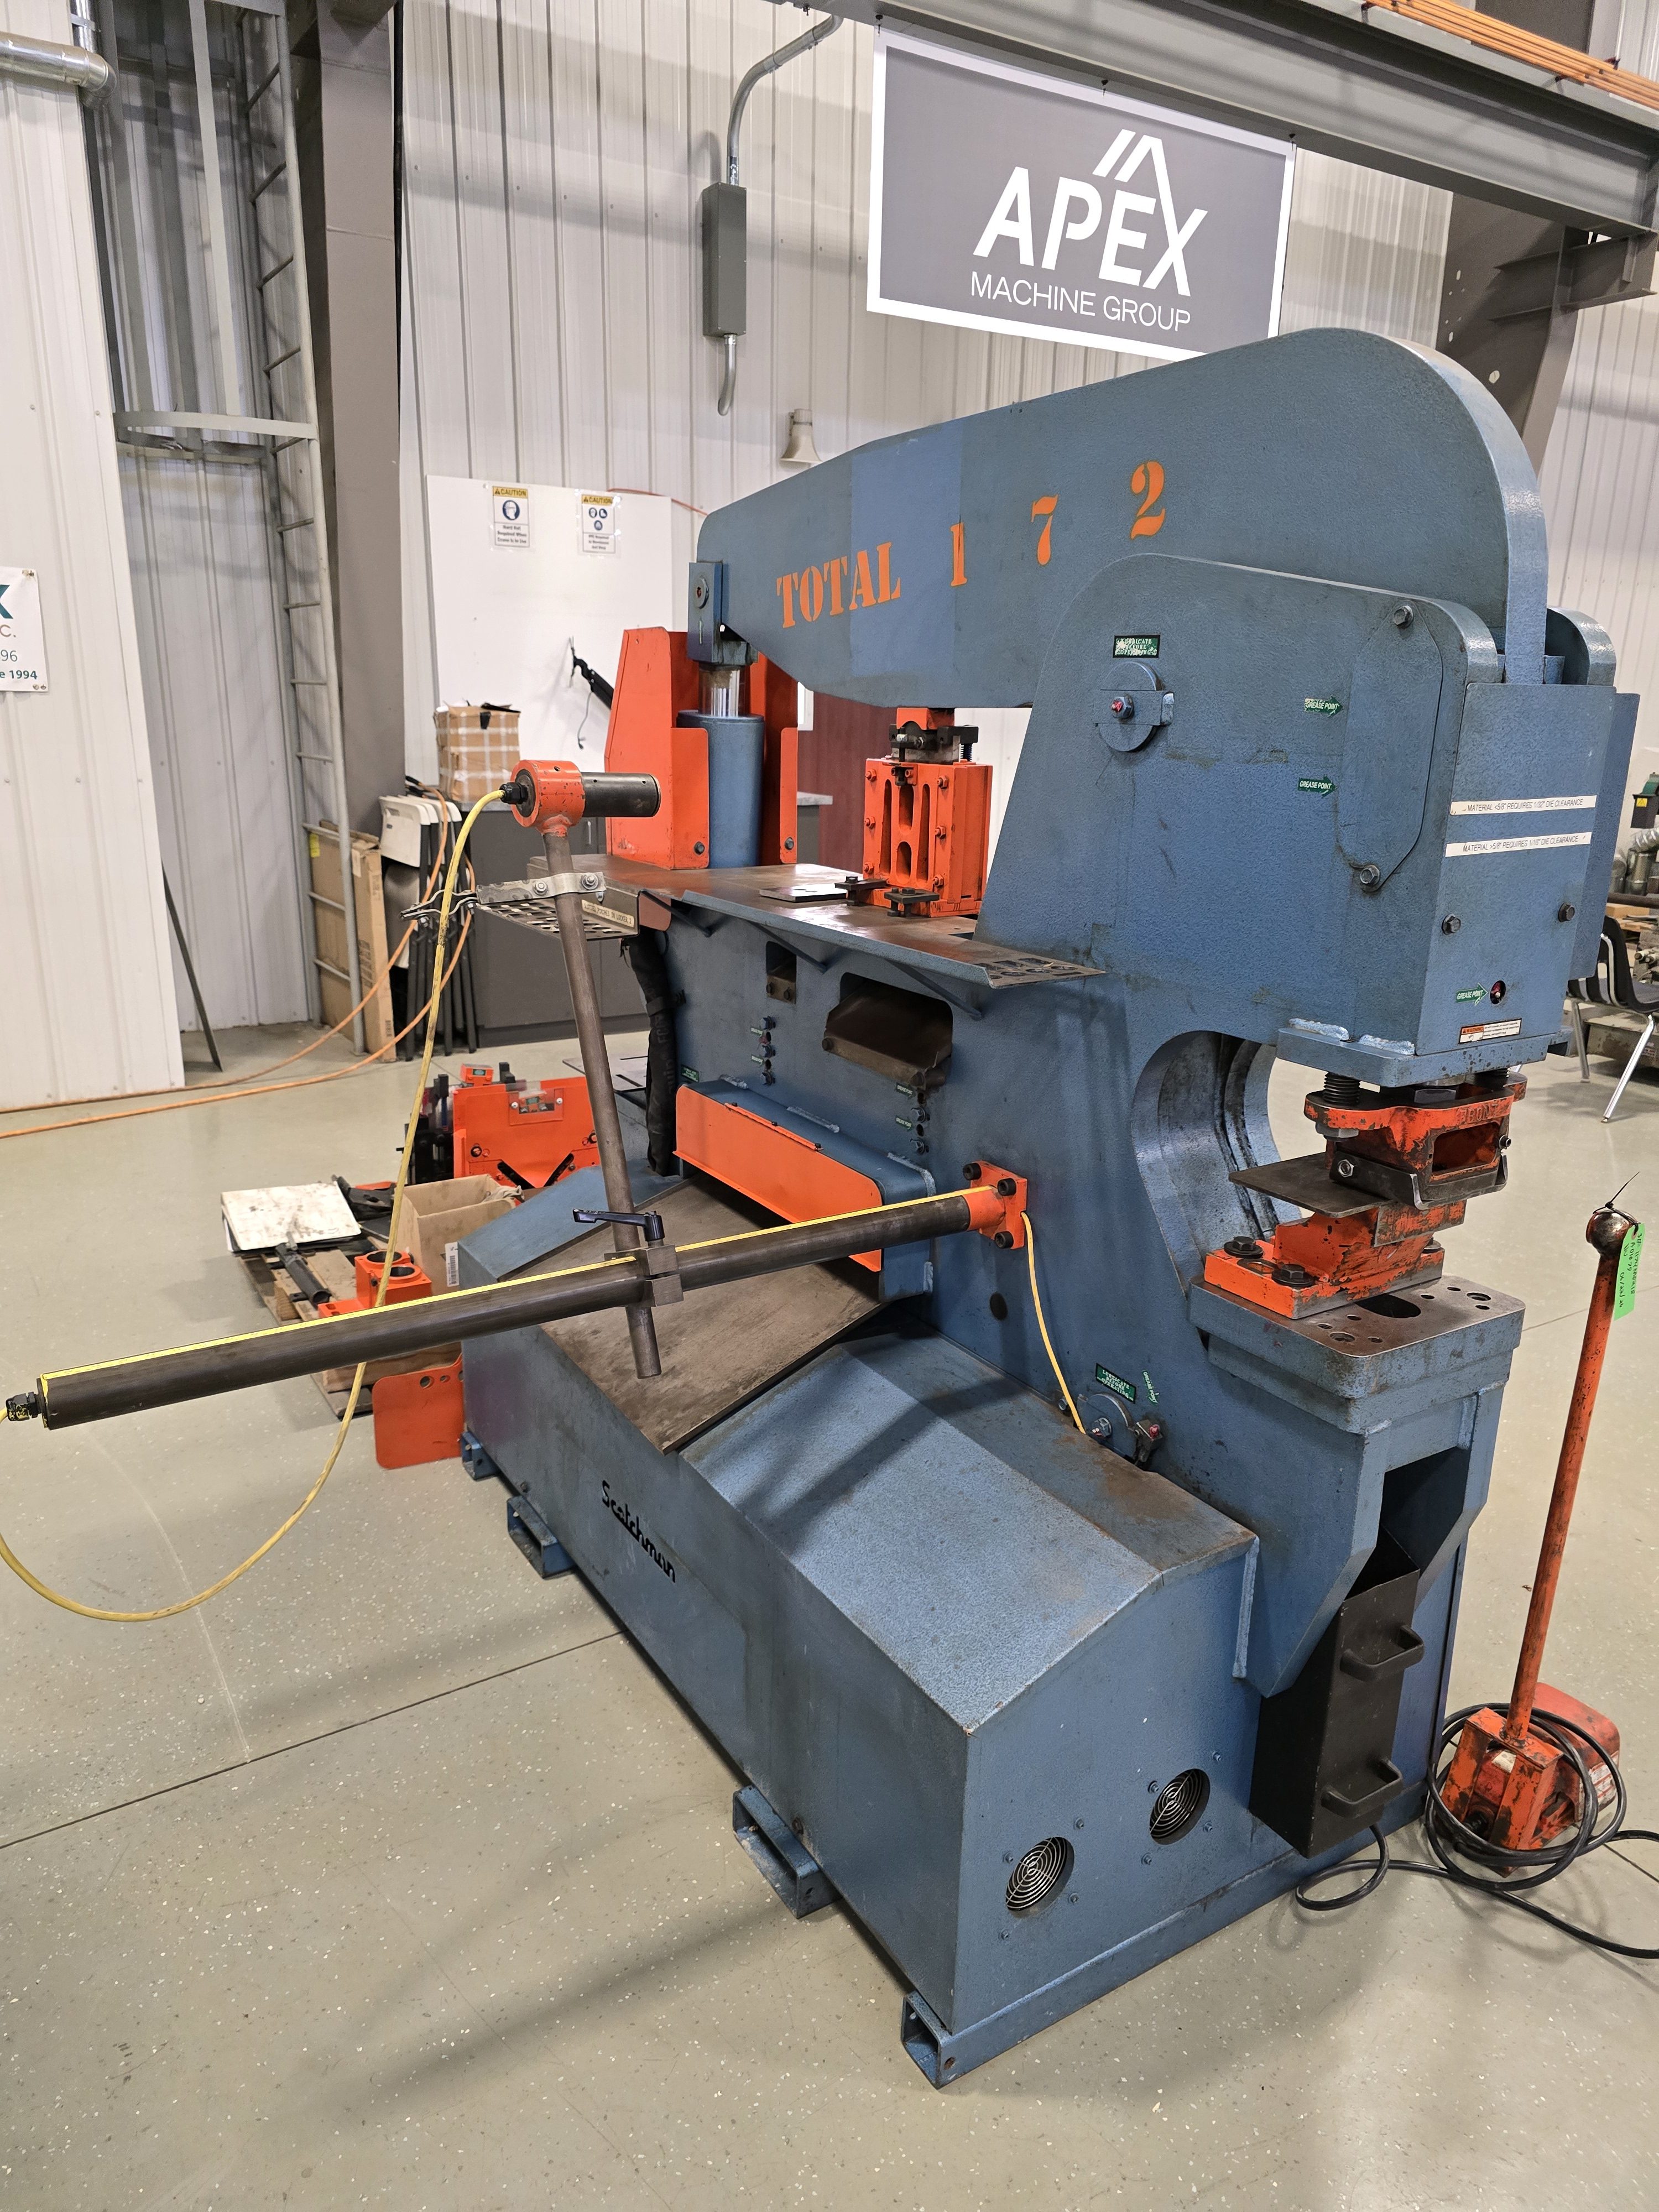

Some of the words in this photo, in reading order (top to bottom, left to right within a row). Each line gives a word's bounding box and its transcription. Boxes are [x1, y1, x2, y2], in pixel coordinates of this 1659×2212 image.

[973, 129, 1208, 297] APEX
[971, 271, 1095, 316] MACHINE
[1103, 295, 1191, 332] GROUP
[500, 489, 526, 497] CAUTION
[589, 496, 613, 504] CAUTION
[776, 542, 901, 628] TOTAL
[950, 521, 968, 587] 1
[1031, 494, 1058, 566] 7
[1130, 461, 1166, 540] 2
[9, 670, 38, 680] 1994
[1300, 780, 1318, 789] GREASE
[1507, 801, 1533, 810] REQUIRES
[1554, 799, 1583, 807] CLEARANCE
[1463, 843, 1489, 852] MATERIAL
[1503, 840, 1528, 848] REQUIRES
[1550, 835, 1579, 844] CLEARANCE
[1457, 990, 1472, 1000] GREASE
[1102, 1369, 1130, 1389] LUBRICATE
[1105, 1376, 1125, 1391] BEFORE
[1143, 1371, 1154, 1390] GREASE
[1101, 1378, 1129, 1399] OPERATING
[602, 1480, 676, 1583] Scotchman
